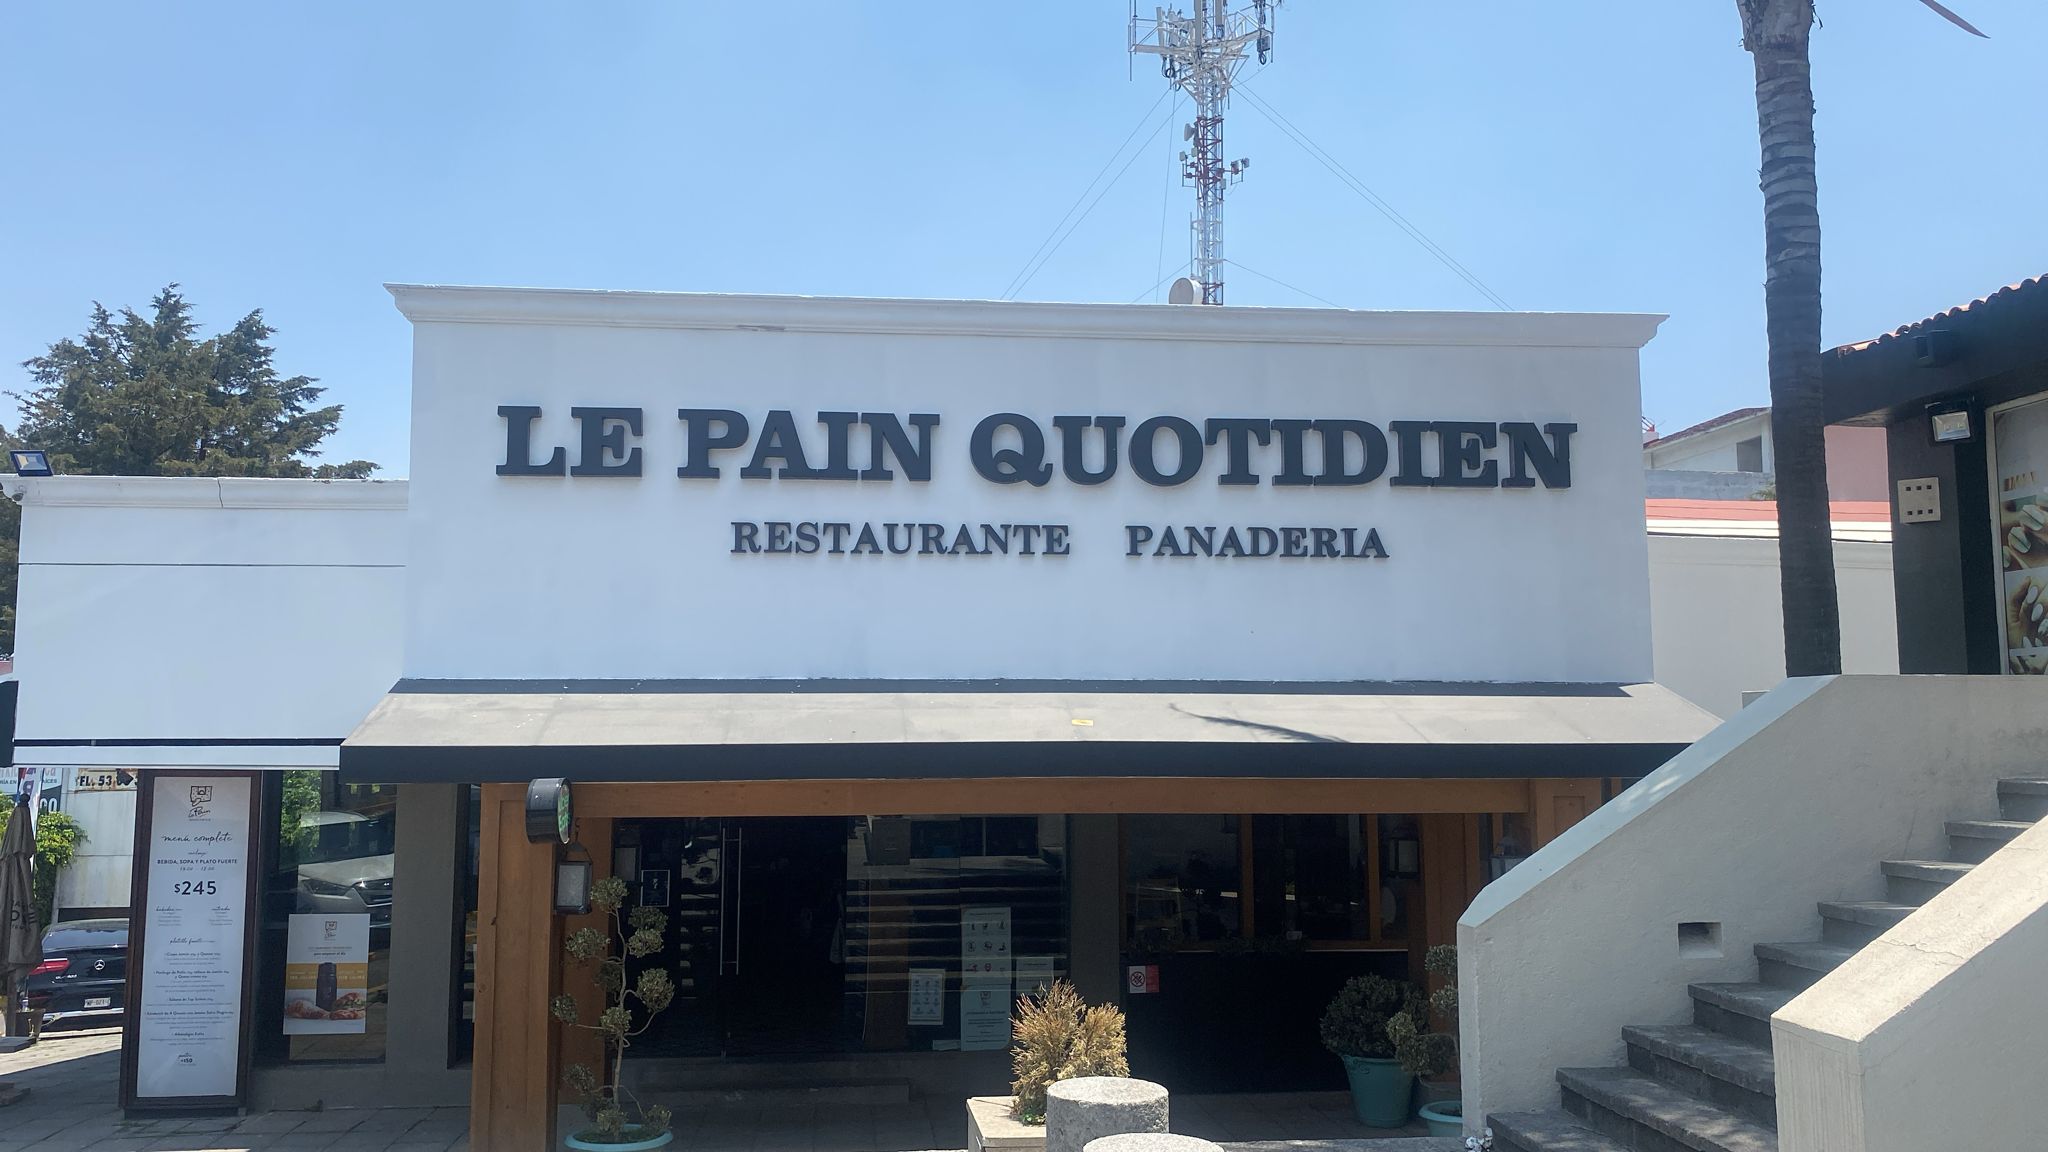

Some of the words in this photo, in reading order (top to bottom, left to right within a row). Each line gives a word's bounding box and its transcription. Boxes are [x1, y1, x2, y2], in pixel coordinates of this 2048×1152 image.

[496, 405, 643, 478] LE
[677, 408, 940, 482] PAIN
[969, 412, 1578, 489] QUOTIDIEN
[730, 521, 1071, 556] RESTAURANTE
[1125, 525, 1390, 559] PANADERIA
[174, 880, 217, 896] $245
